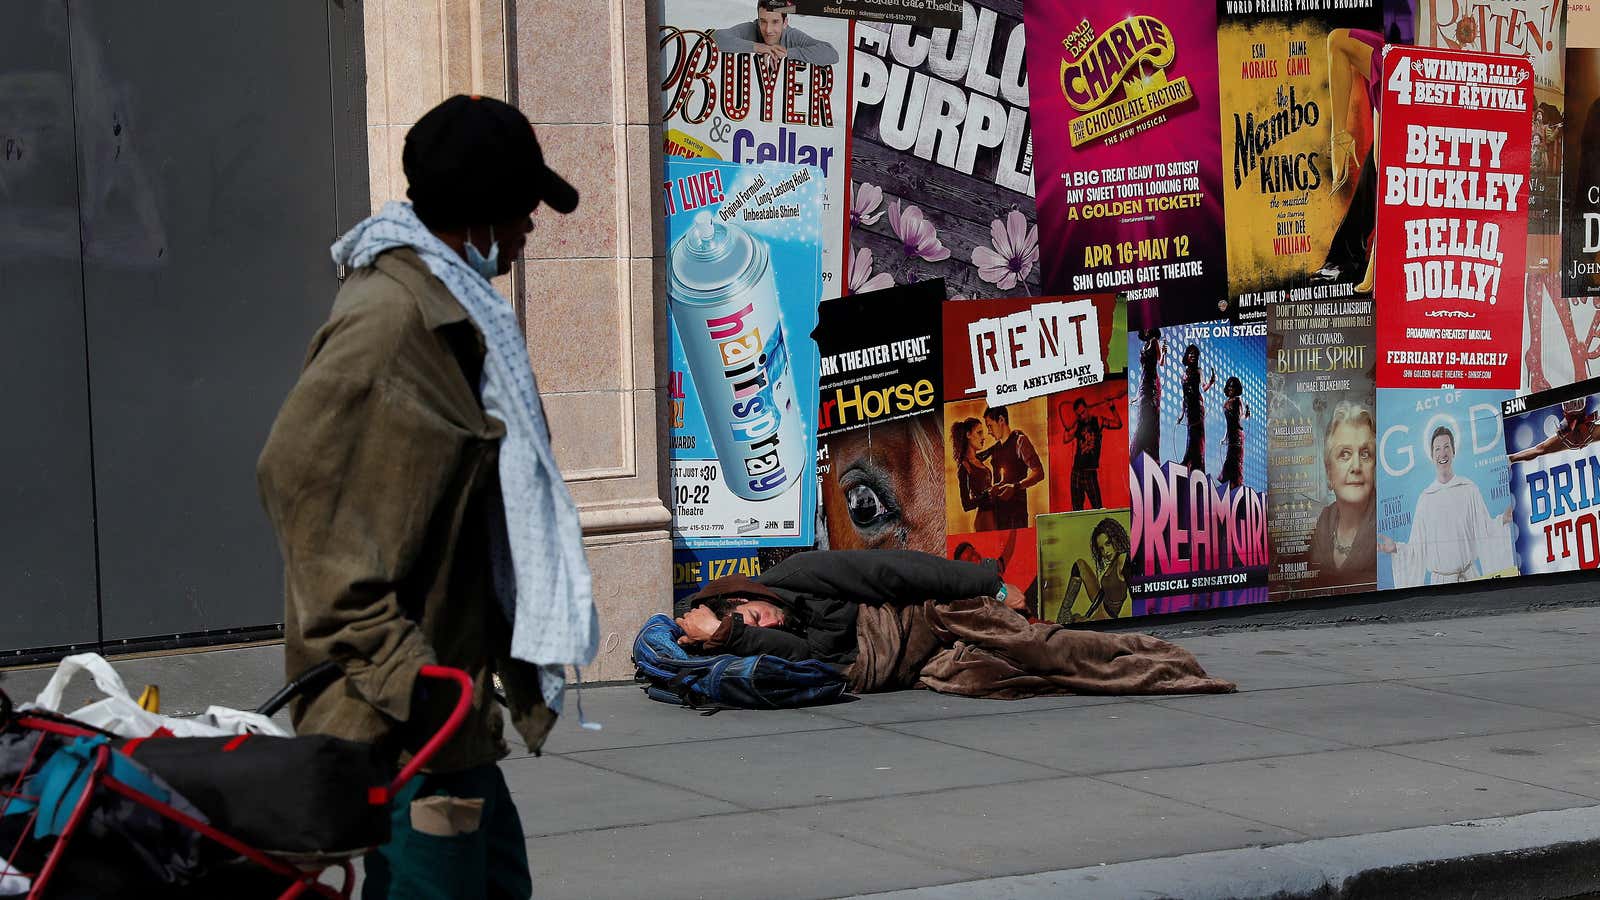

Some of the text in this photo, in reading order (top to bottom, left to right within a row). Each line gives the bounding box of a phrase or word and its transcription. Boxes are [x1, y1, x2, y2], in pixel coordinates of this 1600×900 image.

[823, 6, 855, 16] shnsf.com
[902, 0, 924, 9] Gate
[925, 0, 963, 12] Theatre
[1227, 0, 1374, 14] WORLD PREMIERE PRIOR TO BROADWAY
[1062, 19, 1091, 49] ROALD
[1064, 18, 1168, 105] CHARLIE
[1252, 41, 1307, 58] ESAI JAIME
[1242, 58, 1311, 80] MORALES CAMIL
[1388, 56, 1488, 105] 4 WINNER
[1488, 64, 1518, 77] TONY
[1276, 84, 1289, 108] the
[1414, 82, 1527, 110] BEST REVIVAL
[1072, 81, 1189, 136] AND CHOCOLATE FACTORY
[709, 116, 732, 143] &
[852, 49, 1035, 198] PURPL
[1075, 130, 1085, 140] THE
[1104, 114, 1167, 146] THE NEW MUSICAL
[1233, 85, 1320, 190] Mambo
[1405, 124, 1508, 169] BETTY
[732, 127, 834, 178] Cellar
[1073, 170, 1100, 187] BIG
[1101, 168, 1125, 183] TREAT
[1127, 165, 1153, 180] READY
[1155, 164, 1166, 178] TO
[1168, 160, 1199, 175] SATISFY
[1260, 152, 1322, 194] KINGS
[679, 170, 724, 211] LIVE!
[719, 173, 766, 222] Original Formula!
[754, 168, 811, 207] Long-Lasting Hold!
[1066, 177, 1200, 204] ANY SWEET TOOTH LOOKING FOR
[1385, 166, 1524, 211] BUCKLEY
[1068, 206, 1079, 221] A
[1082, 200, 1143, 219] GOLDEN
[1270, 192, 1309, 209] the musical
[743, 204, 800, 222] Unbeatable Shine!
[1276, 219, 1306, 236] BILLY DEE
[1084, 235, 1190, 268] APR 16-MAY 12
[1273, 235, 1312, 256] WILLIAMS
[1404, 218, 1505, 266] HELLO,
[1073, 261, 1203, 291] SHN GOLDEN GATE THEATRE
[1403, 260, 1502, 305] DOLLY!
[1123, 287, 1159, 301] HNSF.COM
[1239, 282, 1354, 307] MAY 24-JUNE 19 GOLDEN GATE THEATRE
[1276, 301, 1372, 318] DON'T MISS ANGELA LANSBURY
[1185, 324, 1268, 340] LIVE ON STAGE
[1282, 319, 1294, 330] HER
[1294, 318, 1309, 330] TONY
[1356, 316, 1372, 327] ROLE!
[1406, 327, 1492, 341] BROADWAY'S GREATEST MUSICAL
[976, 314, 1087, 375] RENT
[839, 345, 891, 372] THEATER
[1277, 345, 1367, 374] BLITHE SPIRIT
[1387, 350, 1508, 366] FEBRUARY 19-MARCH 17
[996, 365, 1091, 395] 20TH ANNIVERSARY
[1078, 374, 1099, 386] TOUR
[1296, 380, 1351, 393] MICHAEL BLAKEMORE
[1413, 370, 1431, 378] GOLDEN
[1445, 370, 1464, 379] THEATRE
[706, 303, 788, 492] hairspray
[1415, 391, 1464, 412] ACT OF
[1503, 399, 1527, 415] SHN
[670, 436, 696, 449] WARDS
[1380, 402, 1503, 477] GOD
[683, 467, 699, 477] JUST
[700, 465, 717, 481] $30
[675, 485, 710, 504] 10-22
[677, 505, 704, 516] Theatre
[1384, 501, 1402, 516] DAVID
[1144, 573, 1247, 593] MUSICAL SENSATION
